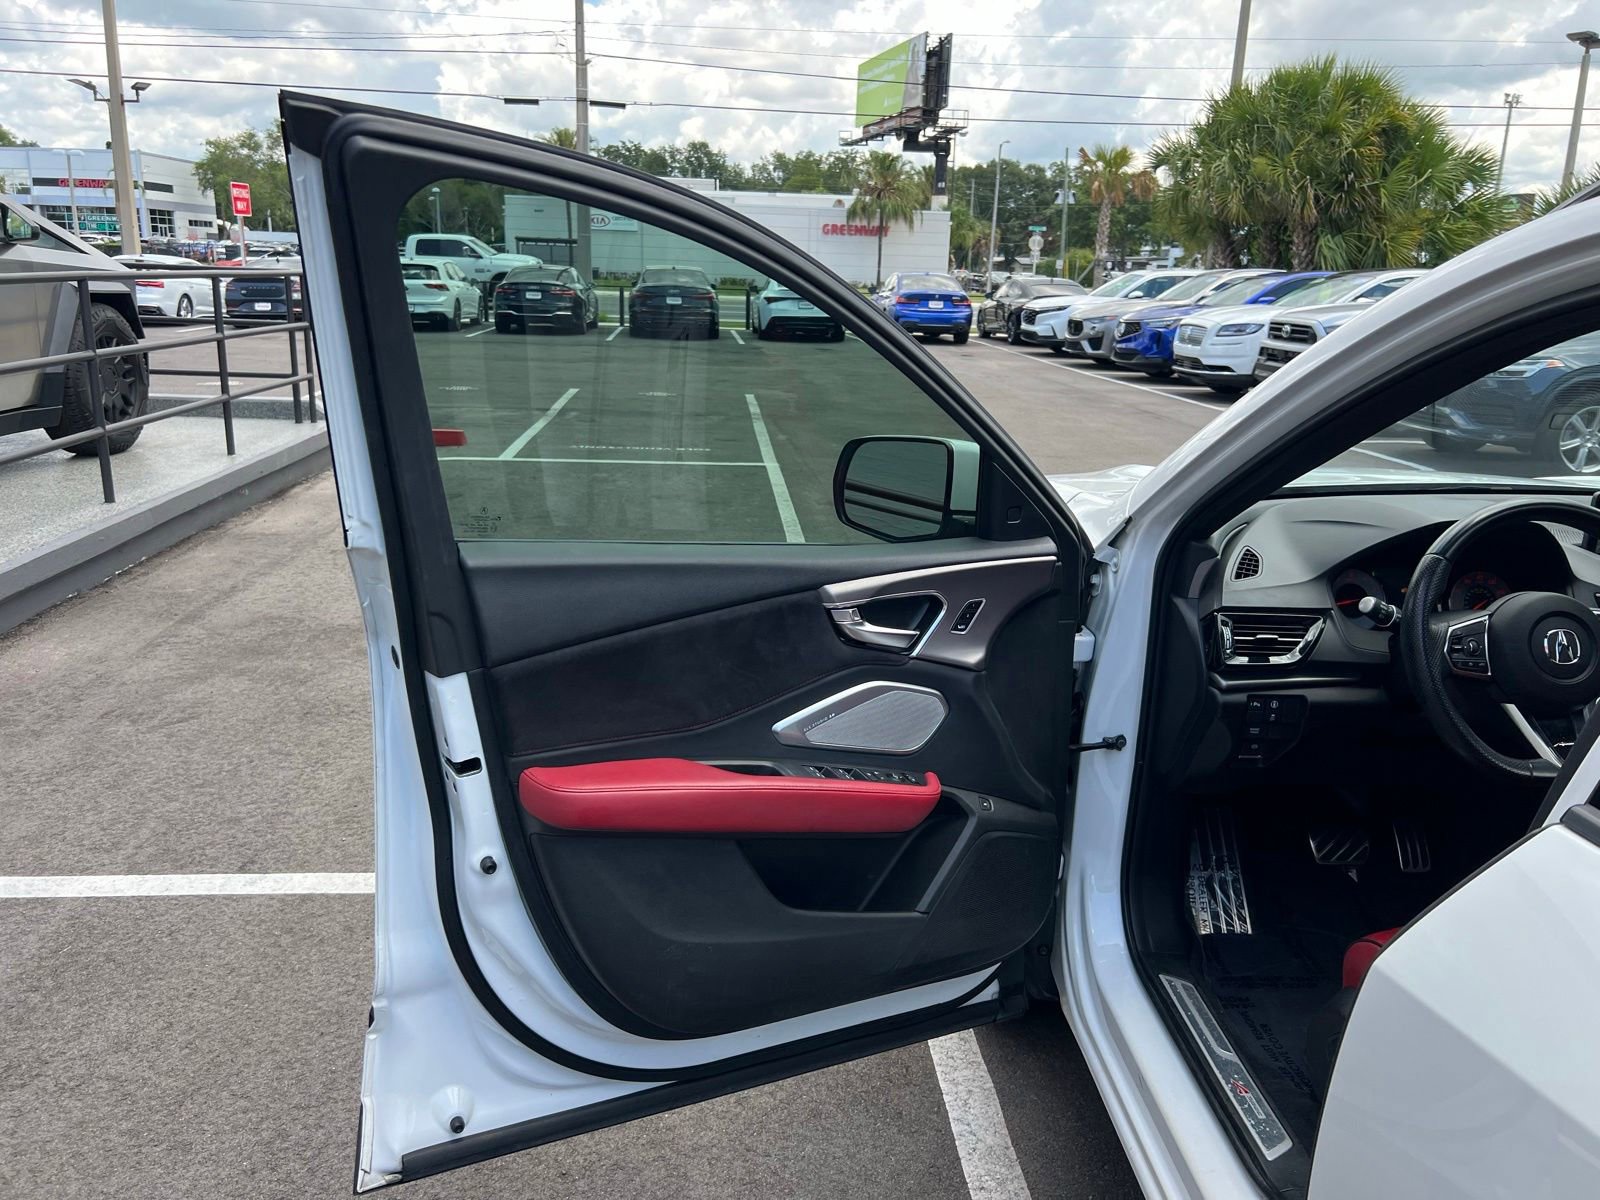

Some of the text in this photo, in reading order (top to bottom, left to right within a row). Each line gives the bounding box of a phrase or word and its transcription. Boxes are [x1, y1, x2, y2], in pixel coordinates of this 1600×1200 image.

[58, 178, 109, 188] GRENWAY
[236, 200, 248, 211] WAY
[591, 217, 606, 225] KIA
[822, 223, 890, 237] GREENWAY
